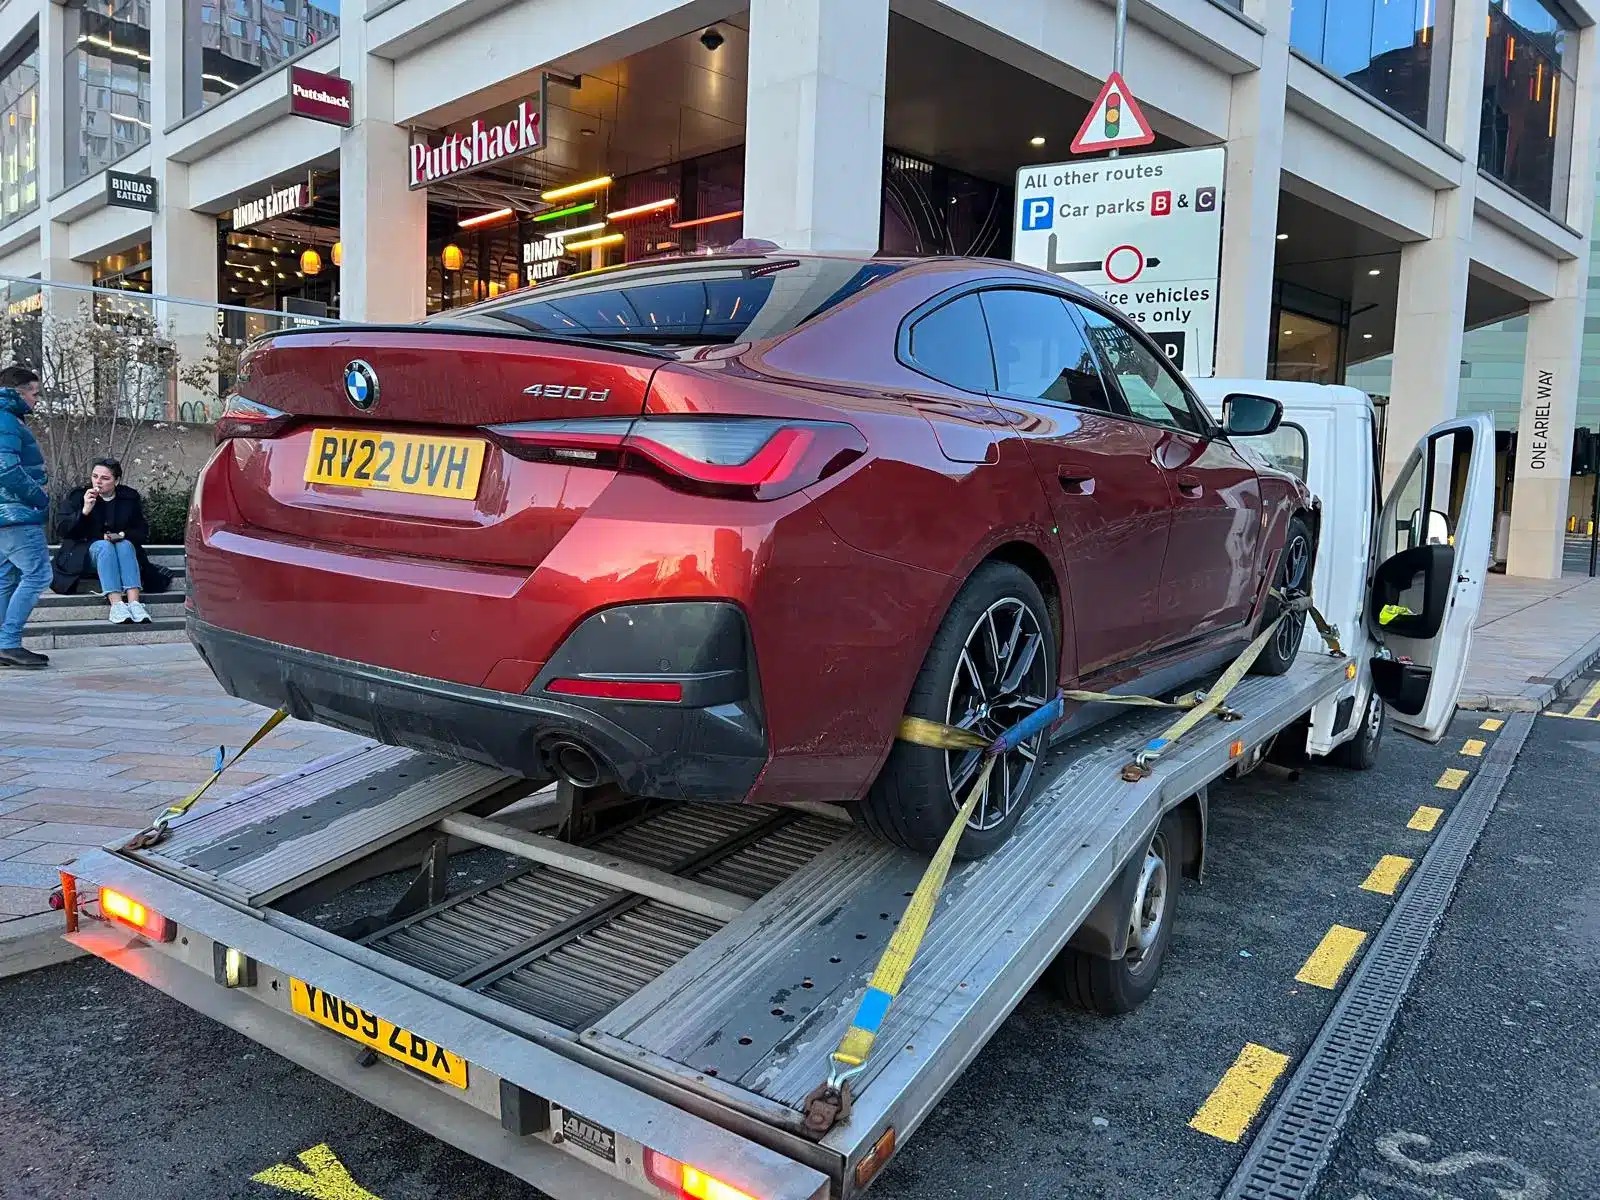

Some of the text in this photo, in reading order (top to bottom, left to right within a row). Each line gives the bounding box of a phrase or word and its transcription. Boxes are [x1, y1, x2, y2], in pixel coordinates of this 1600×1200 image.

[292, 83, 350, 109] Puttshack
[409, 101, 539, 186] Puttshack
[111, 178, 152, 195] BINDAS
[1024, 164, 1163, 189] All other routes
[116, 190, 148, 203] EATERY
[232, 183, 302, 231] BINDAS EATERY
[1029, 191, 1213, 228] P Car parks B & C
[523, 236, 565, 264] BINDAS
[526, 259, 559, 281] EATERY
[1135, 286, 1210, 304] vehicles
[1152, 307, 1192, 324] only
[1164, 343, 1178, 359] D
[1530, 370, 1553, 470] ONE ARIEL WAY
[316, 436, 469, 490] RV22 UVH
[304, 983, 379, 1040] YN69
